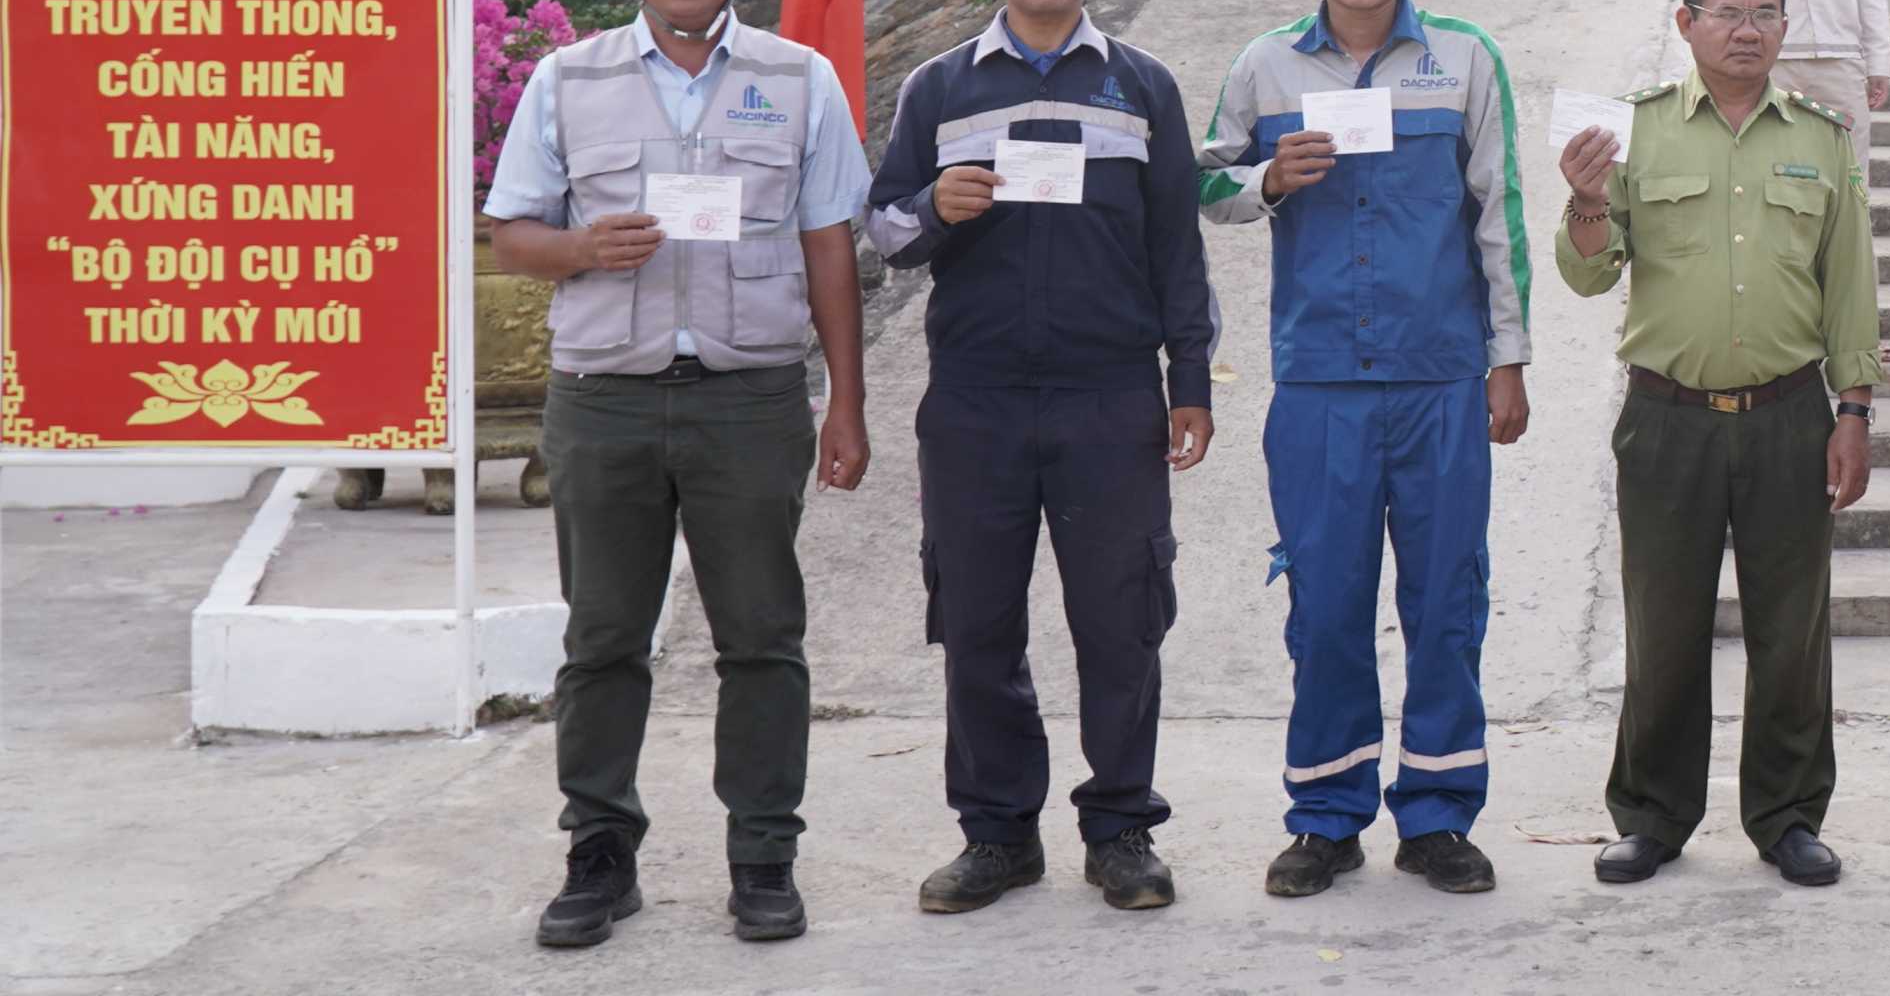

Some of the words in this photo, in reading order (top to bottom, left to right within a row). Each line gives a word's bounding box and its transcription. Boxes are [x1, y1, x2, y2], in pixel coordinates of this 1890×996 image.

[99, 49, 225, 97] CỐNG
[242, 50, 344, 97] HIẾN
[107, 115, 179, 158] TÀI
[197, 116, 334, 163] NĂNG,
[90, 177, 217, 220] XỨNG
[233, 185, 353, 220] DANH
[48, 237, 131, 289] “BỘ
[146, 239, 224, 289] ĐỘI
[241, 246, 299, 289] CỤ
[315, 235, 398, 281] HỒ”
[85, 299, 185, 343] THỜI
[202, 300, 260, 342] KỲ
[276, 300, 360, 343] MỚI
